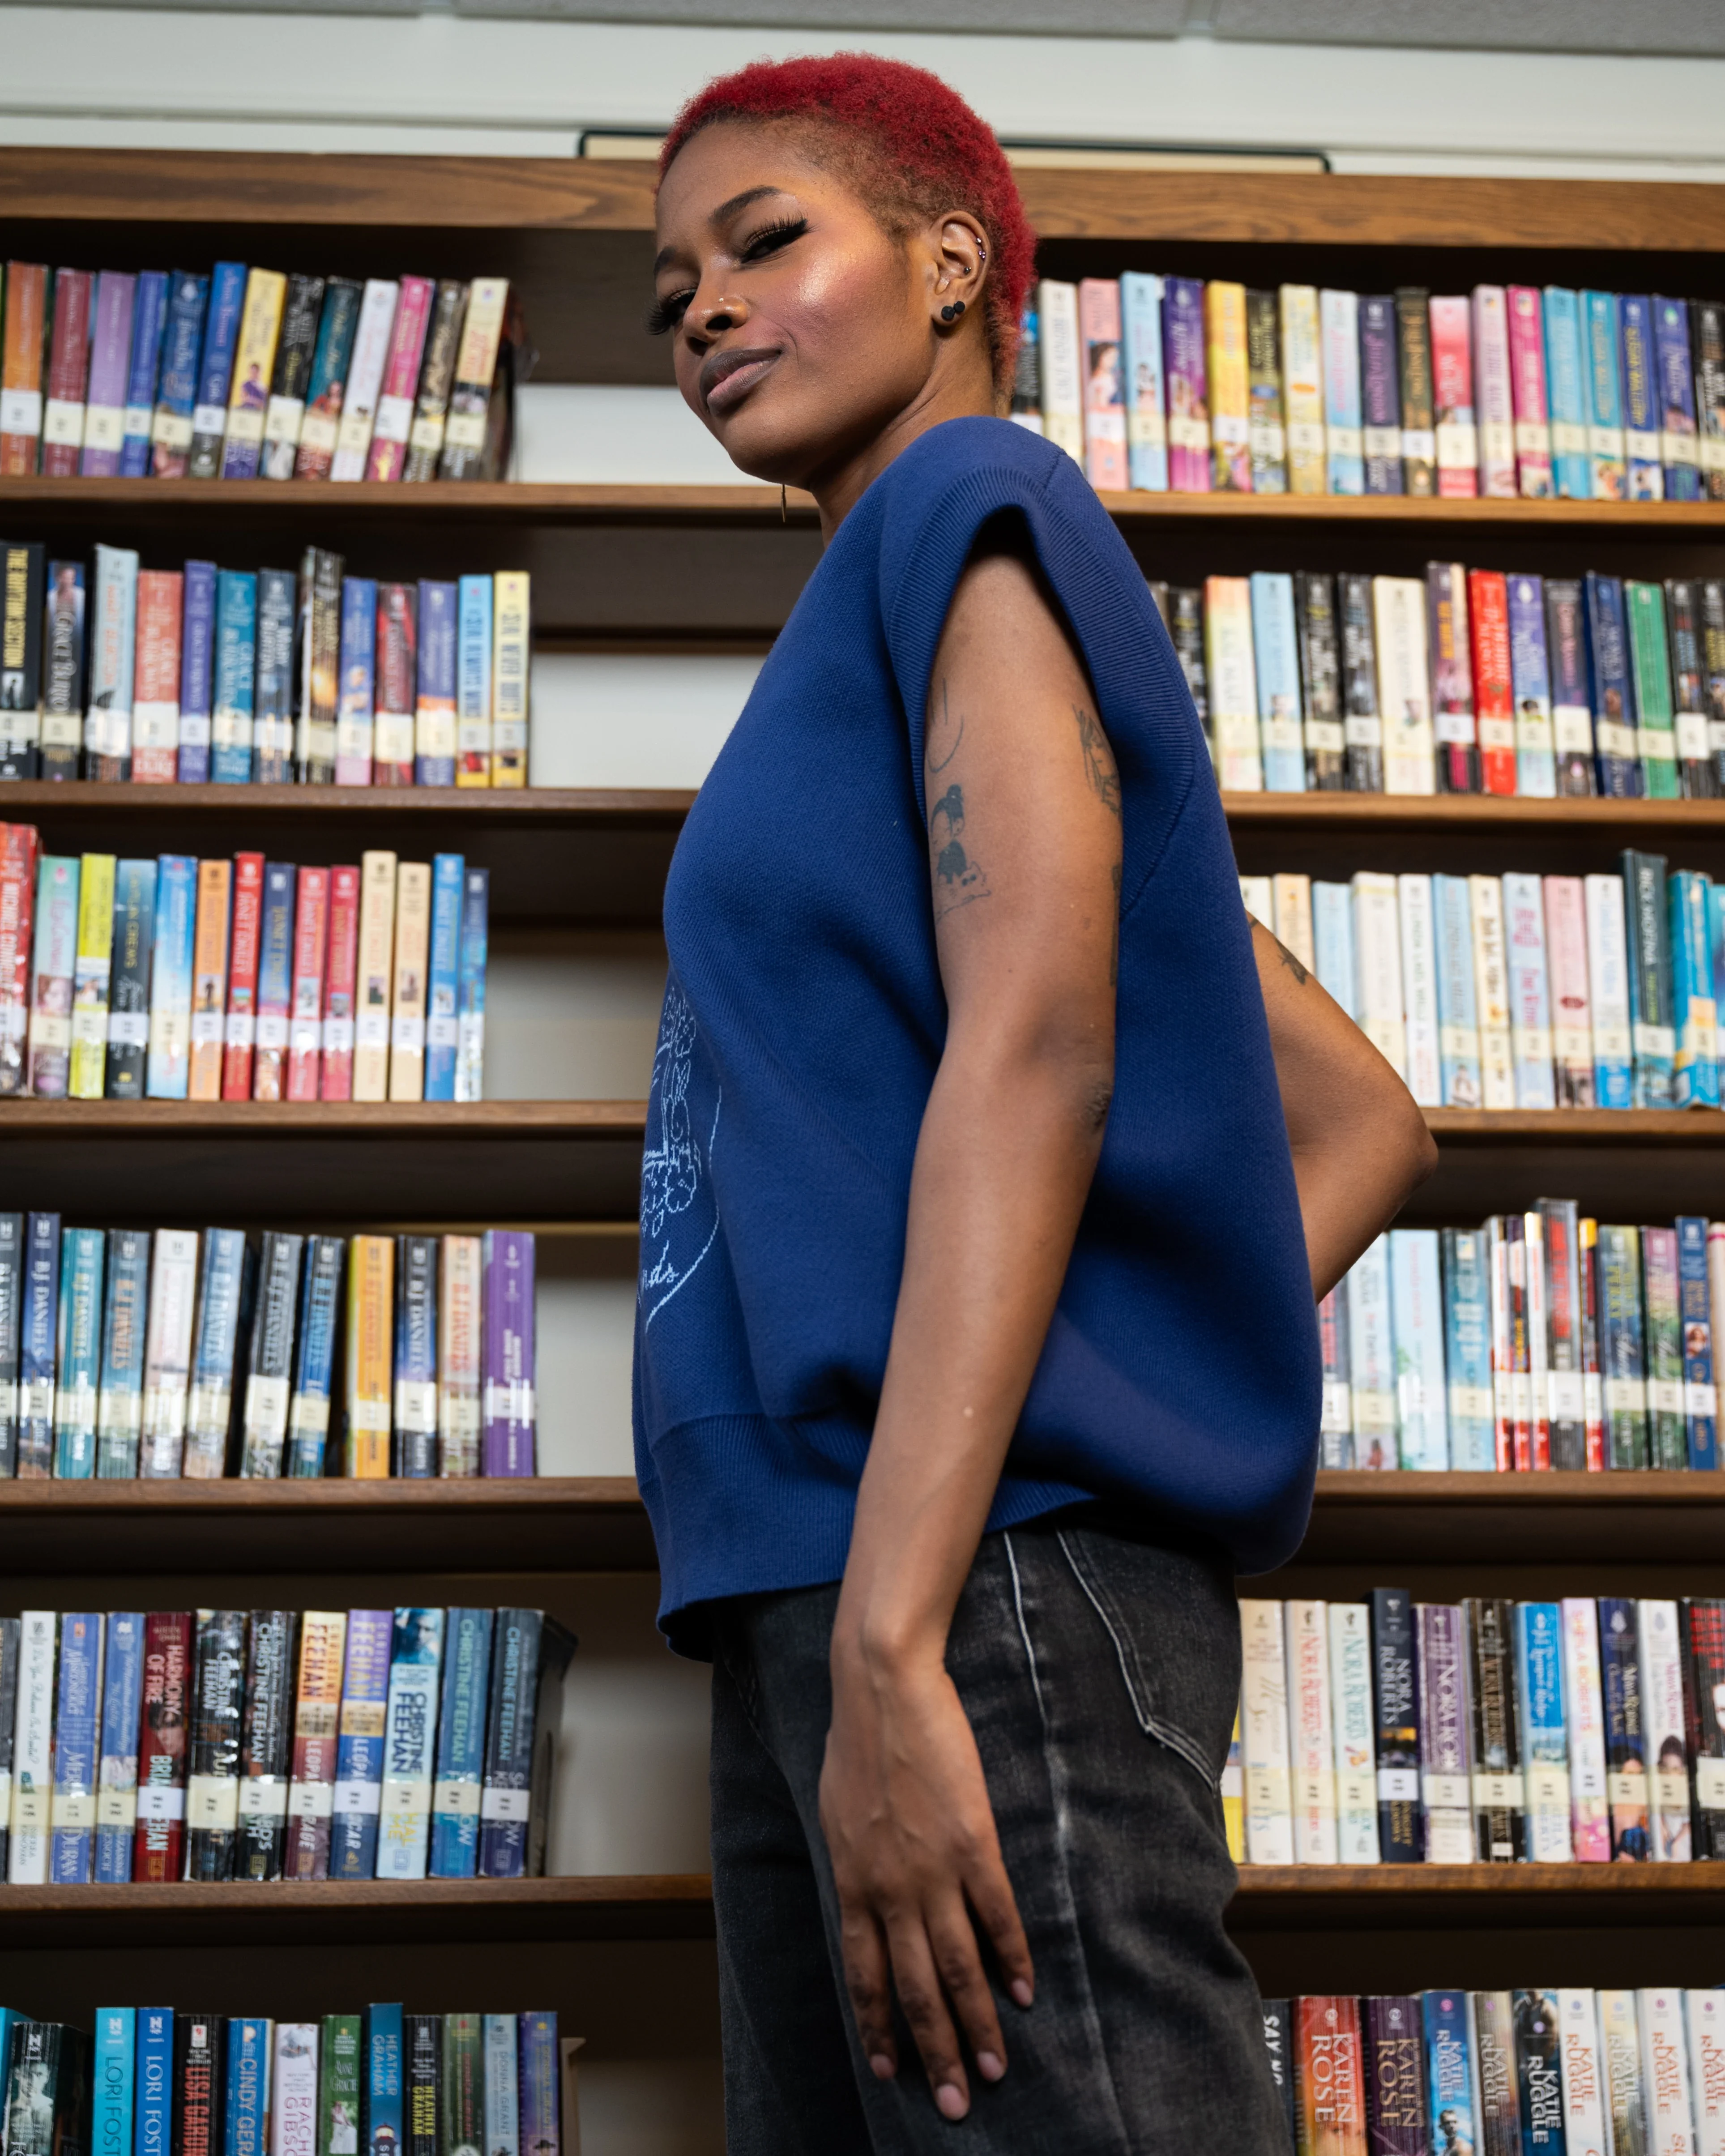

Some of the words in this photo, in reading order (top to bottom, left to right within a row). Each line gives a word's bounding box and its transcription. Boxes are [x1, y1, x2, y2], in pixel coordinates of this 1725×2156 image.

[4, 619, 26, 668] SECTION
[32, 1286, 50, 1357] DANIELS
[145, 1675, 164, 1704] FIRE
[146, 1654, 166, 1674] OF
[165, 1645, 185, 1715] HARMONY
[202, 1659, 218, 1710] FEEHAN
[253, 1623, 271, 1701] CHRISTINE
[303, 1624, 327, 1697] FEEHAN
[349, 1621, 375, 1696] FEEHAN
[455, 1618, 475, 1699] CHRISTINE
[502, 1626, 521, 1701] CHRISTINE
[1379, 1646, 1400, 1725] ROBERTS
[1396, 1659, 1413, 1713] NORA
[1437, 1660, 1458, 1722] NORA
[250, 1703, 269, 1763] FEEHAN
[392, 1692, 414, 1773] FEEHAN
[410, 1692, 427, 1773] CHRISTINE
[452, 1699, 470, 1763] FEEHAN
[498, 1702, 516, 1761] FEEHAN
[298, 1816, 317, 1850] RAGE
[372, 2034, 385, 2096] GRAHAM
[385, 2034, 398, 2096] HEATHER
[1263, 2015, 1282, 2054] SAY
[1436, 2029, 1454, 2102] RUGGLE
[104, 2057, 124, 2100] LORI
[145, 2056, 164, 2101] LORI
[184, 2066, 211, 2101] LISA
[238, 2058, 258, 2112] CINDY
[499, 2050, 510, 2092] DONNA
[1311, 2035, 1336, 2122] ROSE
[1332, 2032, 1357, 2122] KAREN
[1377, 2040, 1401, 2127] ROSE
[1396, 2038, 1418, 2127] KAREN
[1449, 2041, 1465, 2091] KATIE
[1480, 2033, 1499, 2118] RUGGLE
[1493, 2047, 1510, 2105] KATIE
[1565, 2033, 1585, 2117] RUGGLE
[1580, 2047, 1597, 2102] KATIE
[1608, 2034, 1629, 2118] RUGGLE
[1623, 2048, 1640, 2105] KATIE
[1652, 2032, 1671, 2115] RUGGLE
[1665, 2045, 1682, 2101] KATIE
[1700, 2035, 1719, 2118] RUGGLE
[412, 2086, 424, 2135] GRAHAM
[424, 2085, 436, 2135] HEATHER
[500, 2096, 510, 2136] GRANT
[1527, 2055, 1549, 2144] RUGGLE
[1542, 2070, 1562, 2129] KATIE
